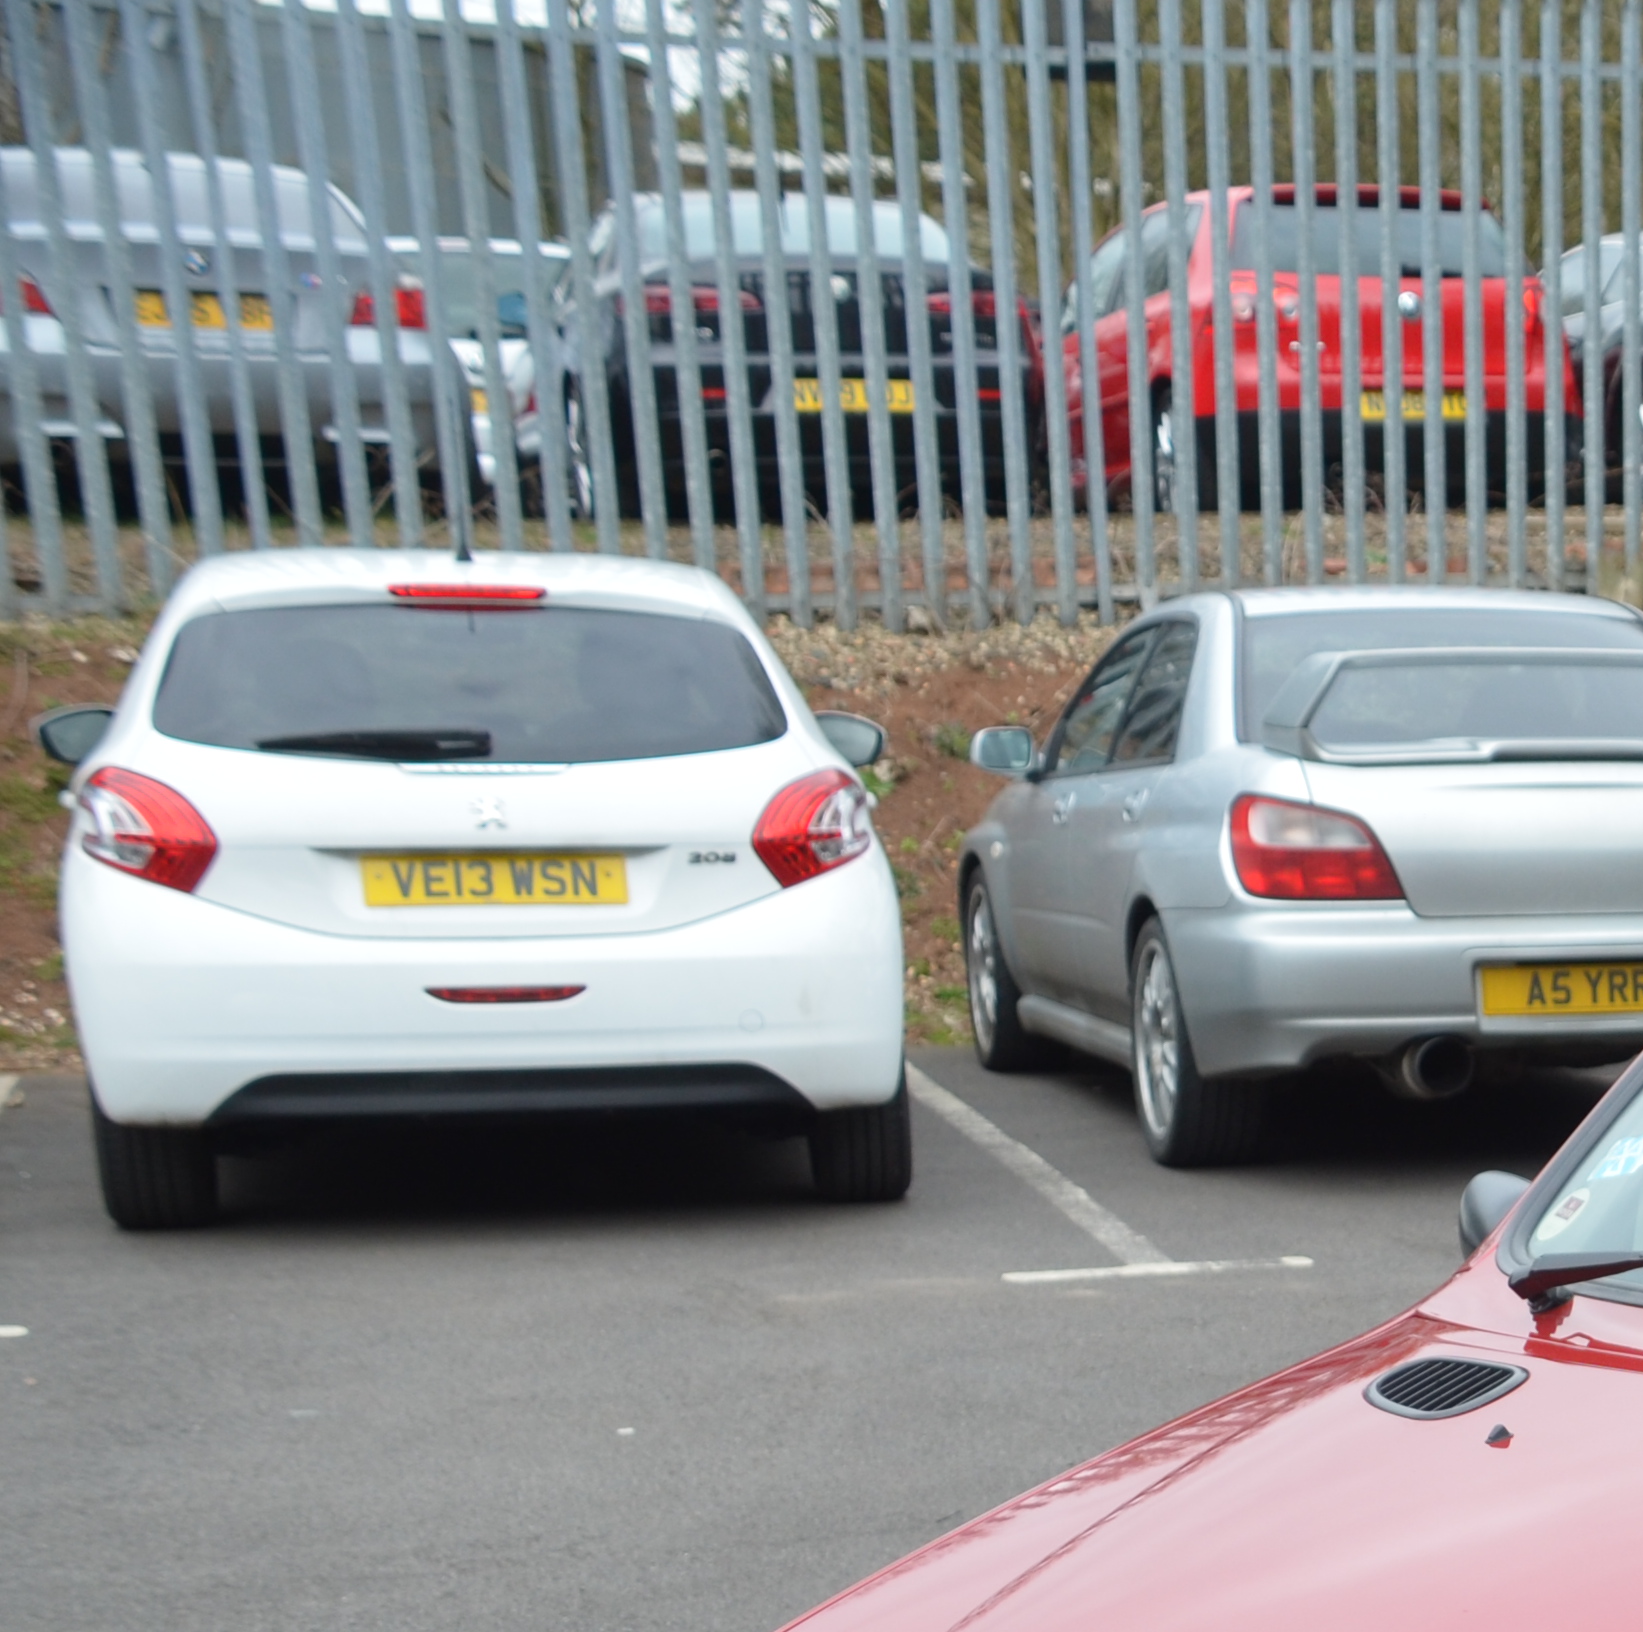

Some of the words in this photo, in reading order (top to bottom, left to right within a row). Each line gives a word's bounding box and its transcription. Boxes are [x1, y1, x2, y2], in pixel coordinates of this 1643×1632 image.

[390, 859, 494, 899] VE13
[507, 859, 600, 898] WSN
[1527, 970, 1572, 1006] A5
